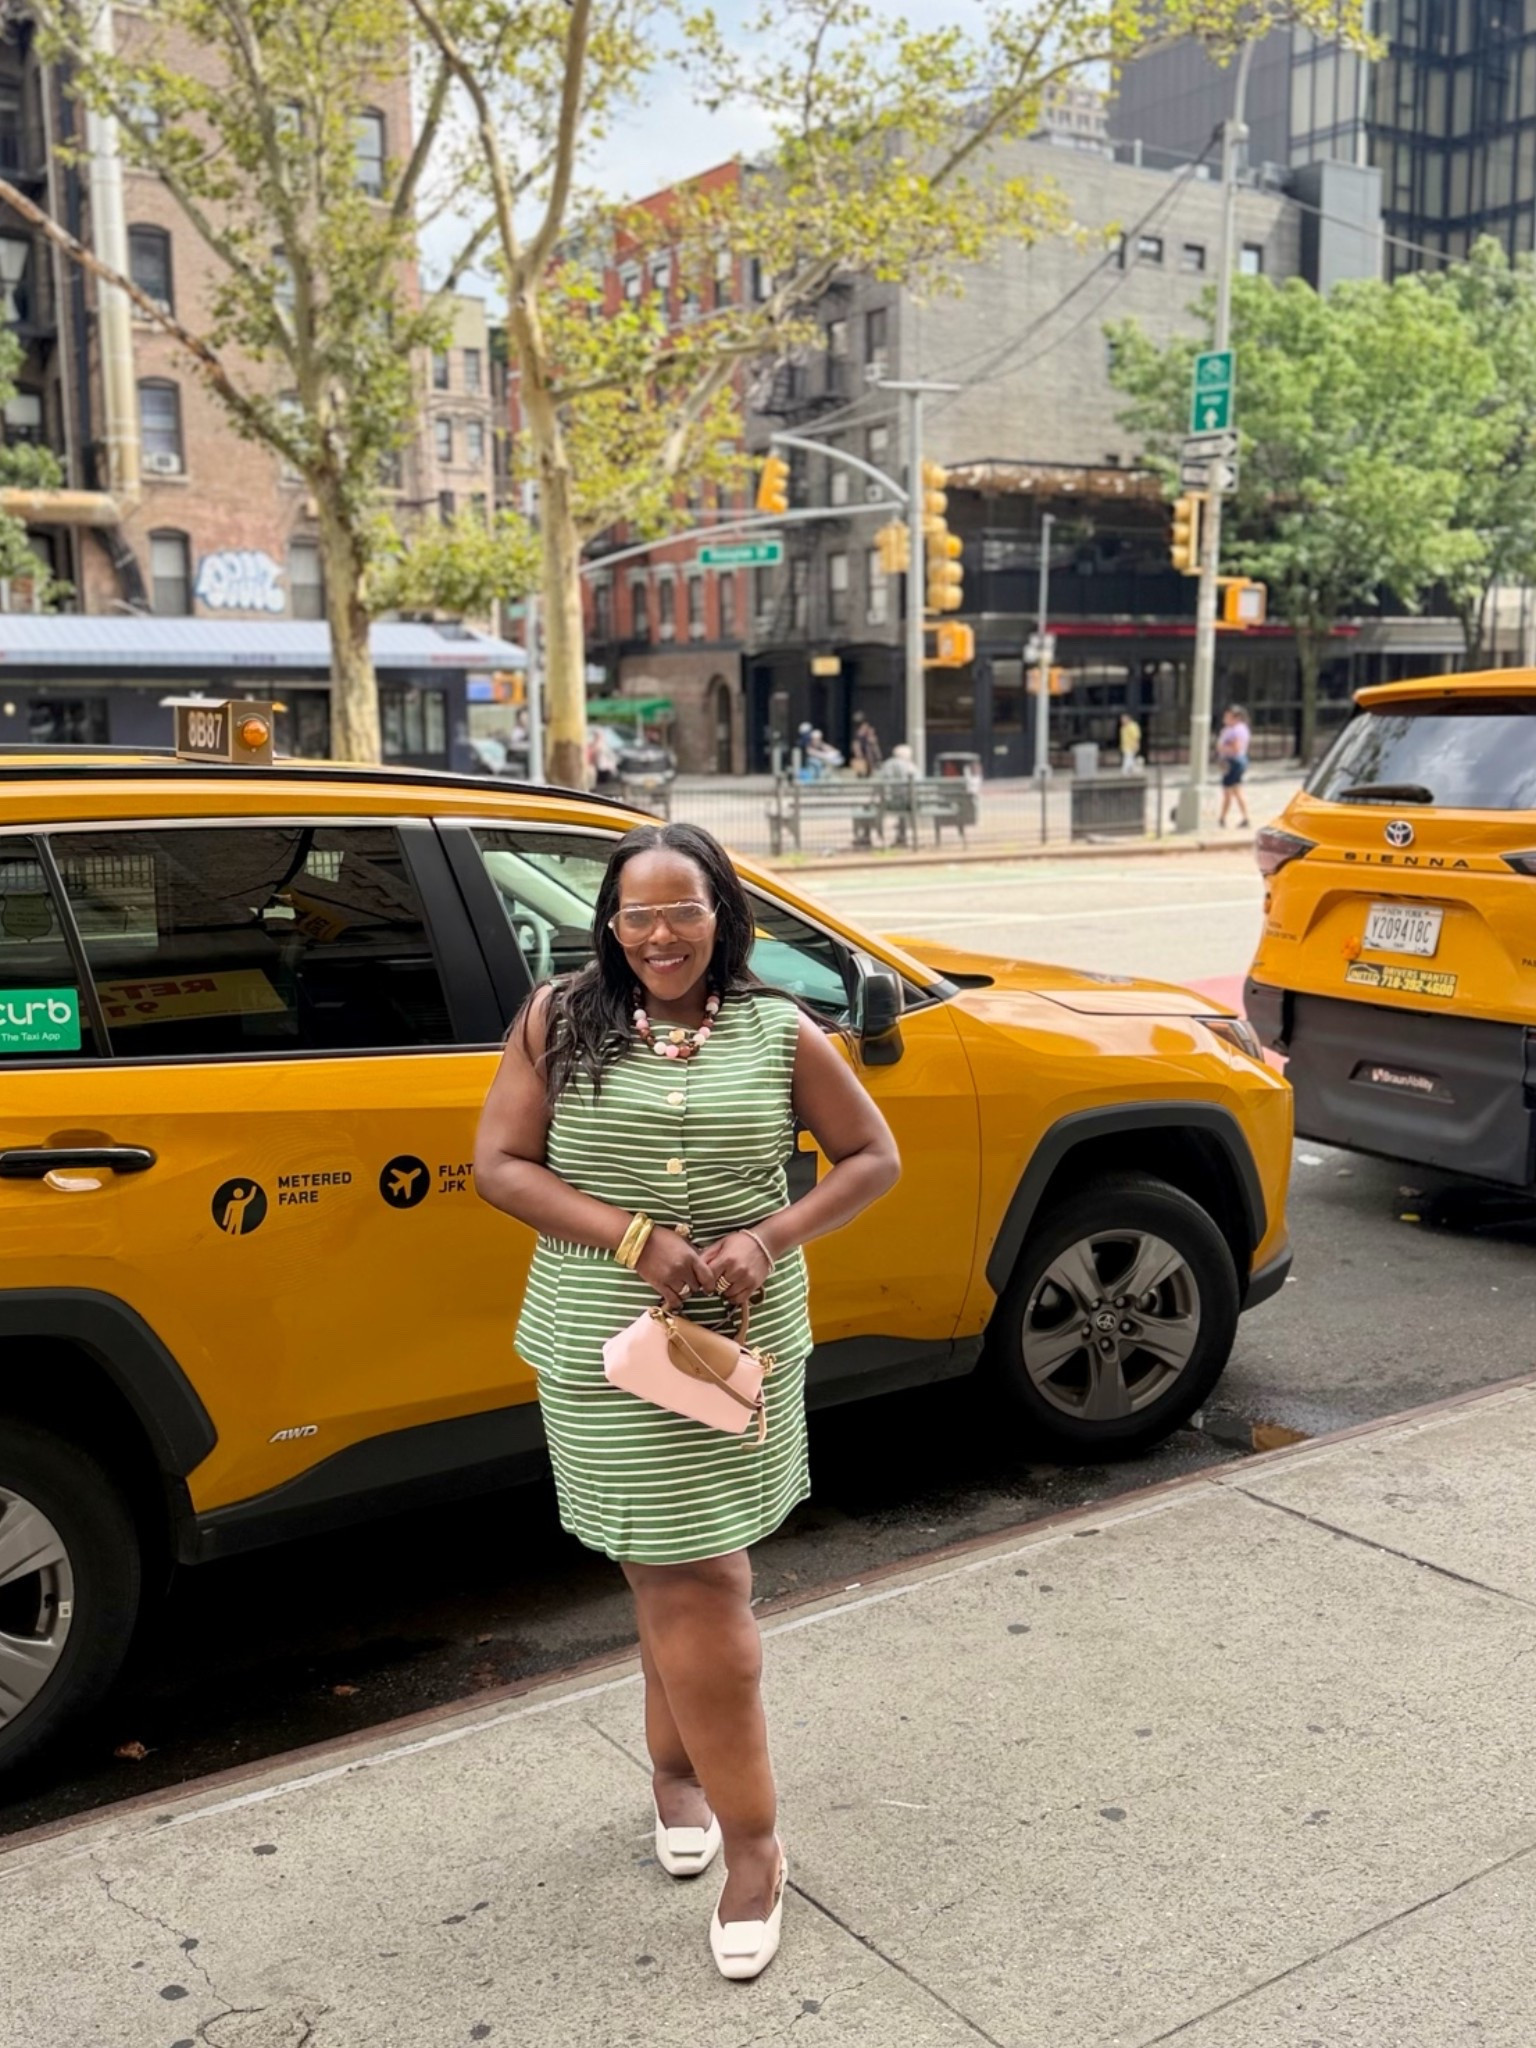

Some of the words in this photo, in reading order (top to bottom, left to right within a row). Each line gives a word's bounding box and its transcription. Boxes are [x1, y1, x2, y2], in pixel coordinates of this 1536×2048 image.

[188, 710, 222, 749] 8B87
[1344, 852, 1469, 868] SIENNA
[1372, 915, 1432, 943] Y209418C
[1383, 965, 1418, 980] DRIVERS
[1420, 969, 1457, 985] WANTED
[1, 1033, 19, 1041] The
[21, 1032, 40, 1041] Taxi
[42, 1031, 61, 1042] App
[438, 1163, 474, 1178] FLAT
[278, 1172, 352, 1188] METERED
[438, 1180, 467, 1194] JFK
[278, 1191, 319, 1206] FARE
[269, 1424, 319, 1443] AWD
